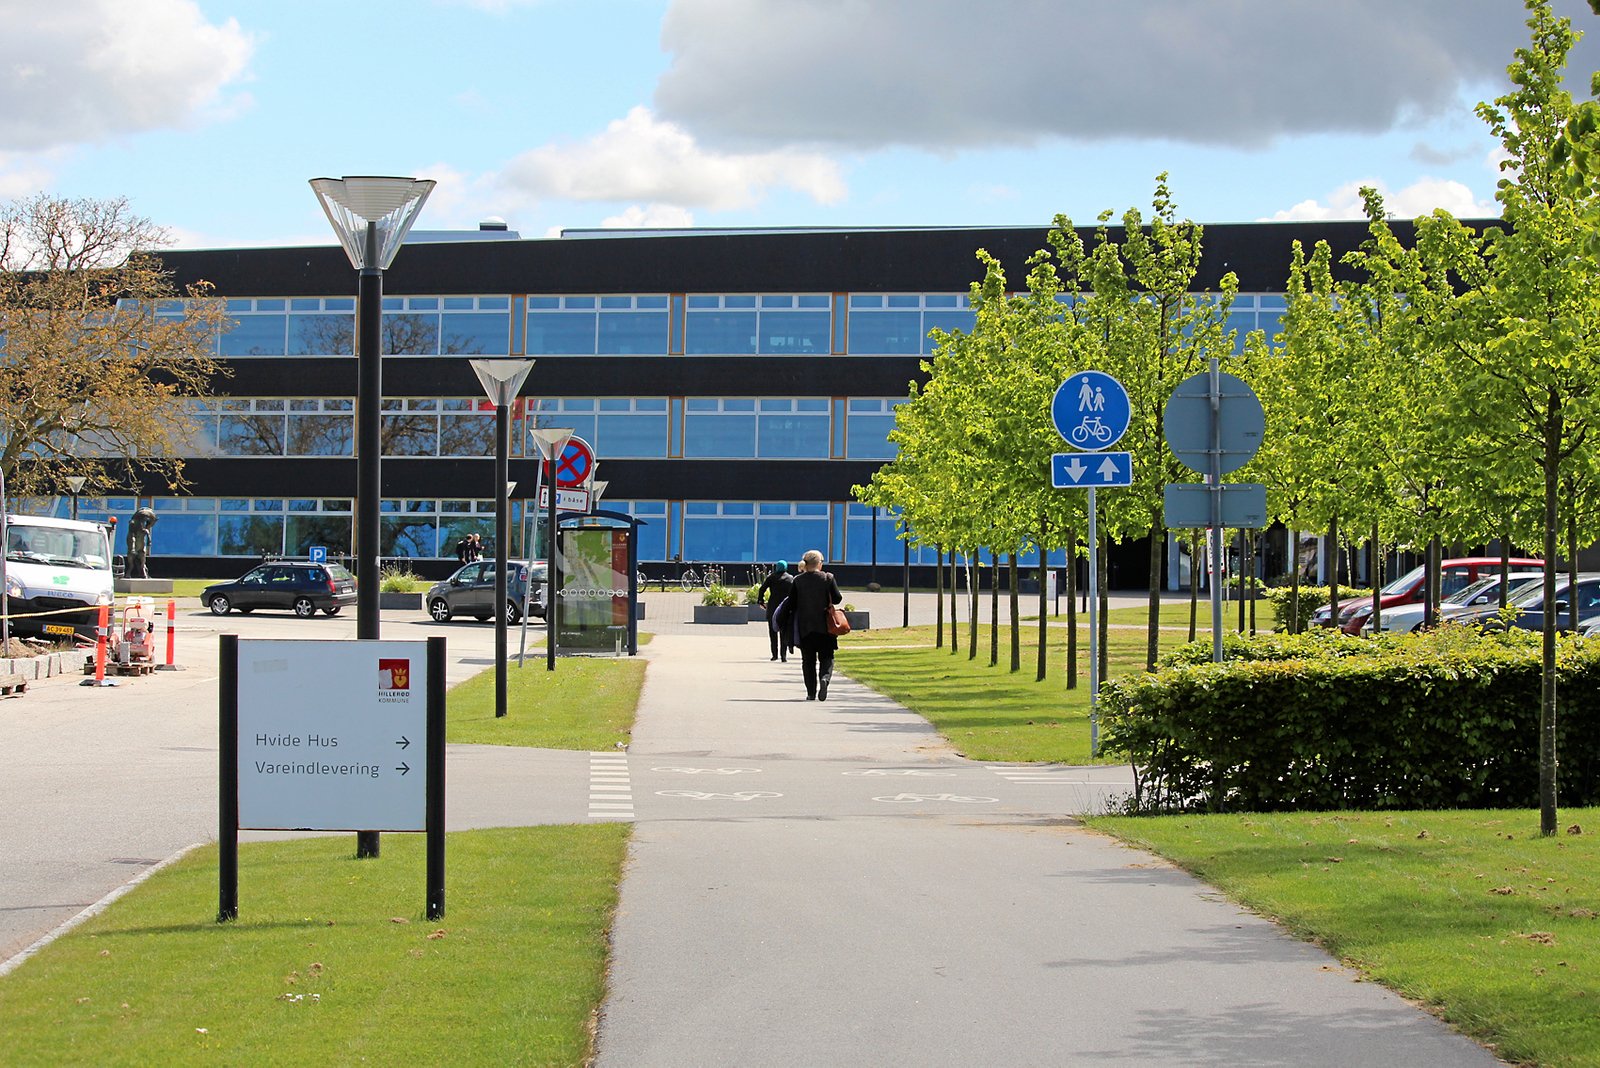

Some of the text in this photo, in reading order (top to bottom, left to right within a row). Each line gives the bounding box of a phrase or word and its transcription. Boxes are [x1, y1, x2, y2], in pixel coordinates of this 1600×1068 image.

[256, 734, 338, 747] Hvide Hus
[255, 761, 380, 778] Vareindlevering
